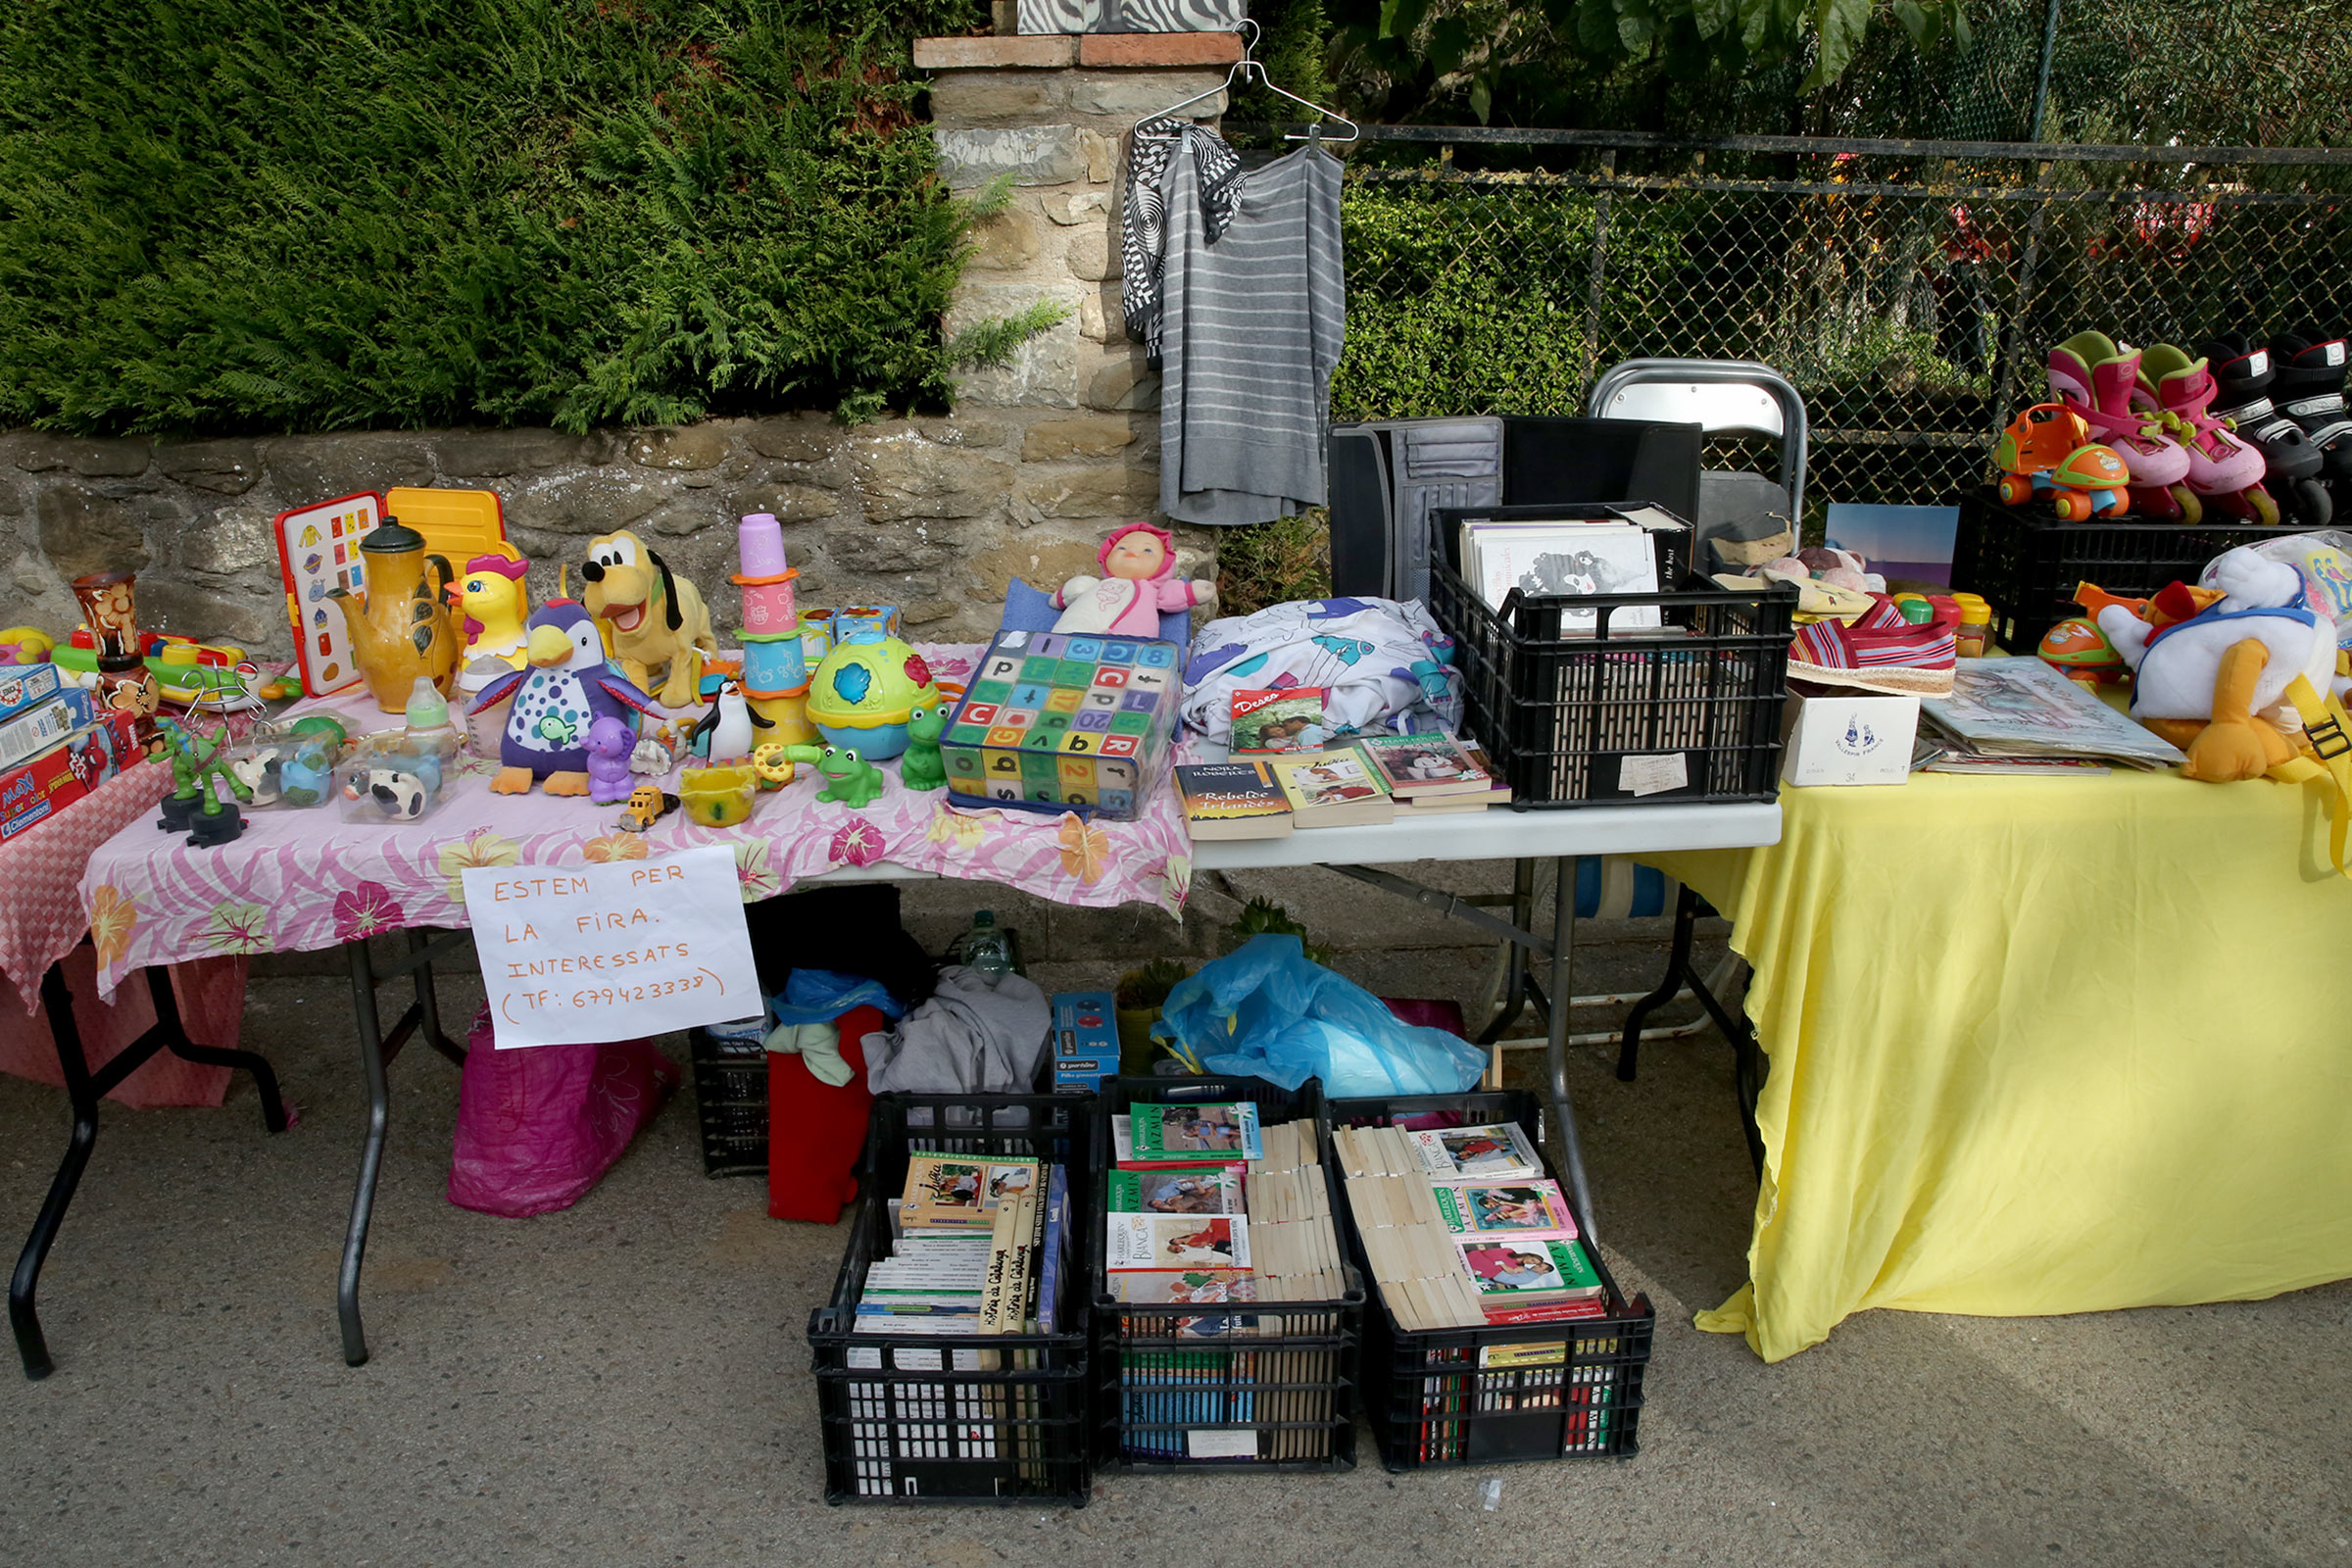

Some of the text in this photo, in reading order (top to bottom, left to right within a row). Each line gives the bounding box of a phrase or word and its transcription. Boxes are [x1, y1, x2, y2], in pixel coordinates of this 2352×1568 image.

[1234, 692, 1280, 712] Deseo
[1197, 791, 1269, 801] Rebelde
[11, 800, 49, 830] Clementoni
[495, 864, 684, 901] ESTEM PER
[505, 923, 539, 943] LA
[508, 943, 689, 978] INTERESSATS
[1152, 1106, 1164, 1152] JAZMIN
[919, 1163, 942, 1200] Julia
[1128, 1173, 1139, 1212] AZMIN
[1133, 1226, 1152, 1260] BIANCA
[1549, 1245, 1577, 1286] AZMIN
